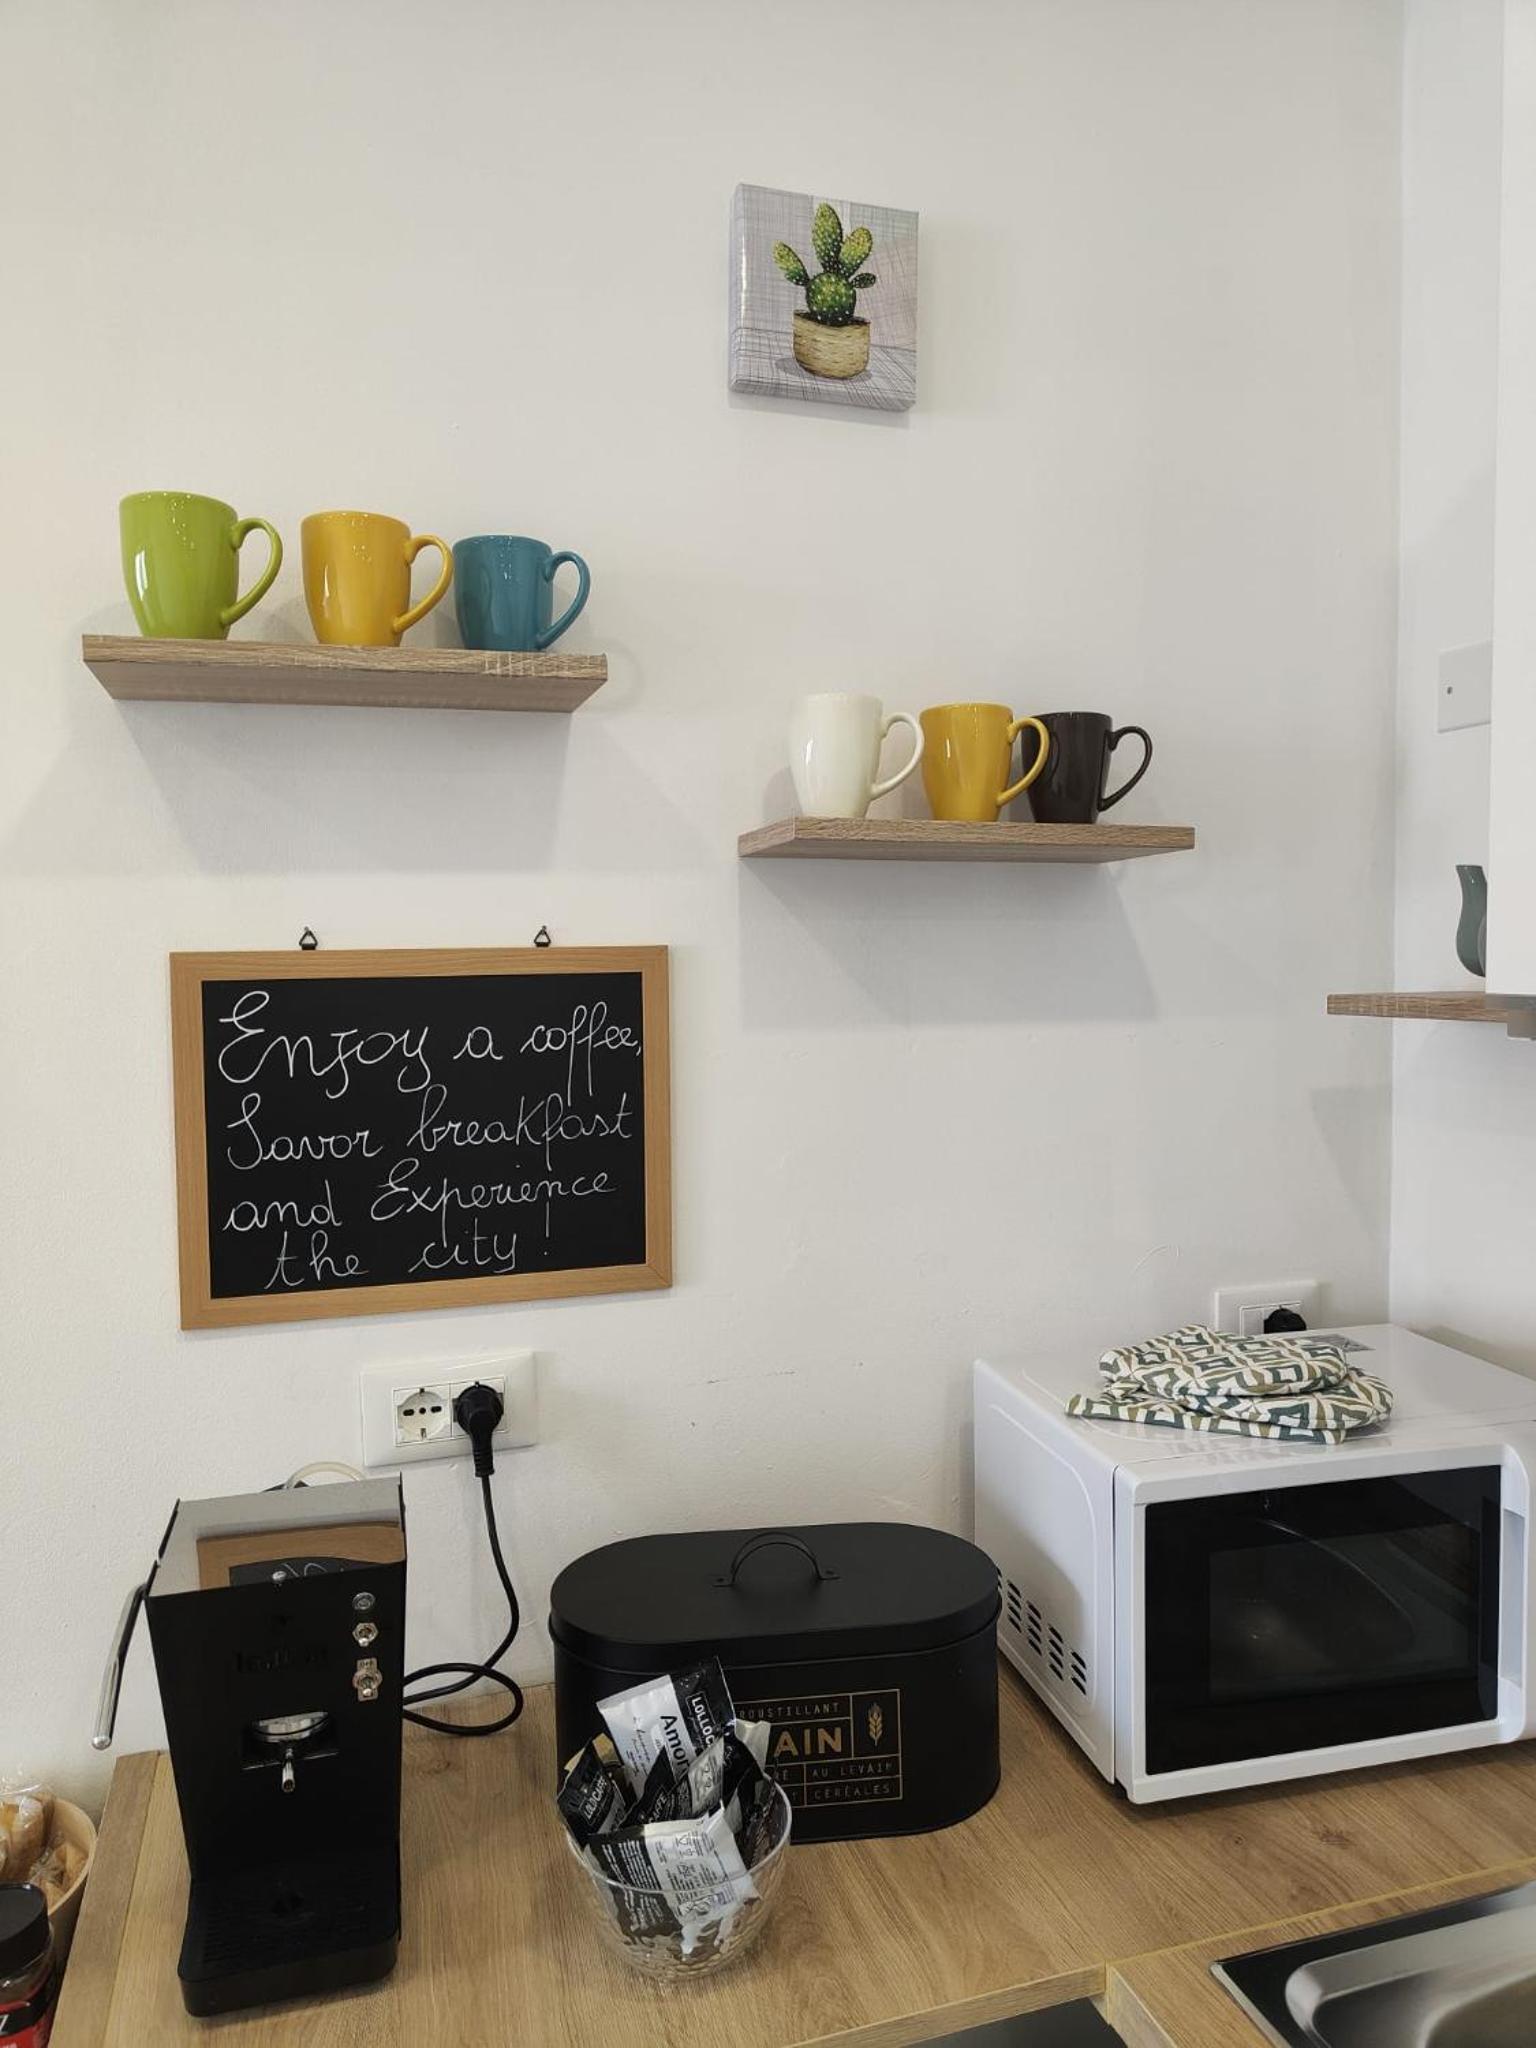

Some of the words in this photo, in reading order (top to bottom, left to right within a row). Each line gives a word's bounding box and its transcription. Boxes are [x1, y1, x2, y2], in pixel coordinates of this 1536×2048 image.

[453, 1026, 503, 1060] a
[520, 1001, 642, 1107] coffee,
[227, 1093, 383, 1170] Savor
[223, 1180, 342, 1232] and
[371, 1158, 617, 1247] Experience
[265, 1230, 369, 1290] the
[691, 1697, 715, 1749] LOLLOC
[738, 1702, 841, 1720] ROUSTILLANT
[660, 1715, 690, 1771] Amor
[773, 1726, 843, 1757] AIN
